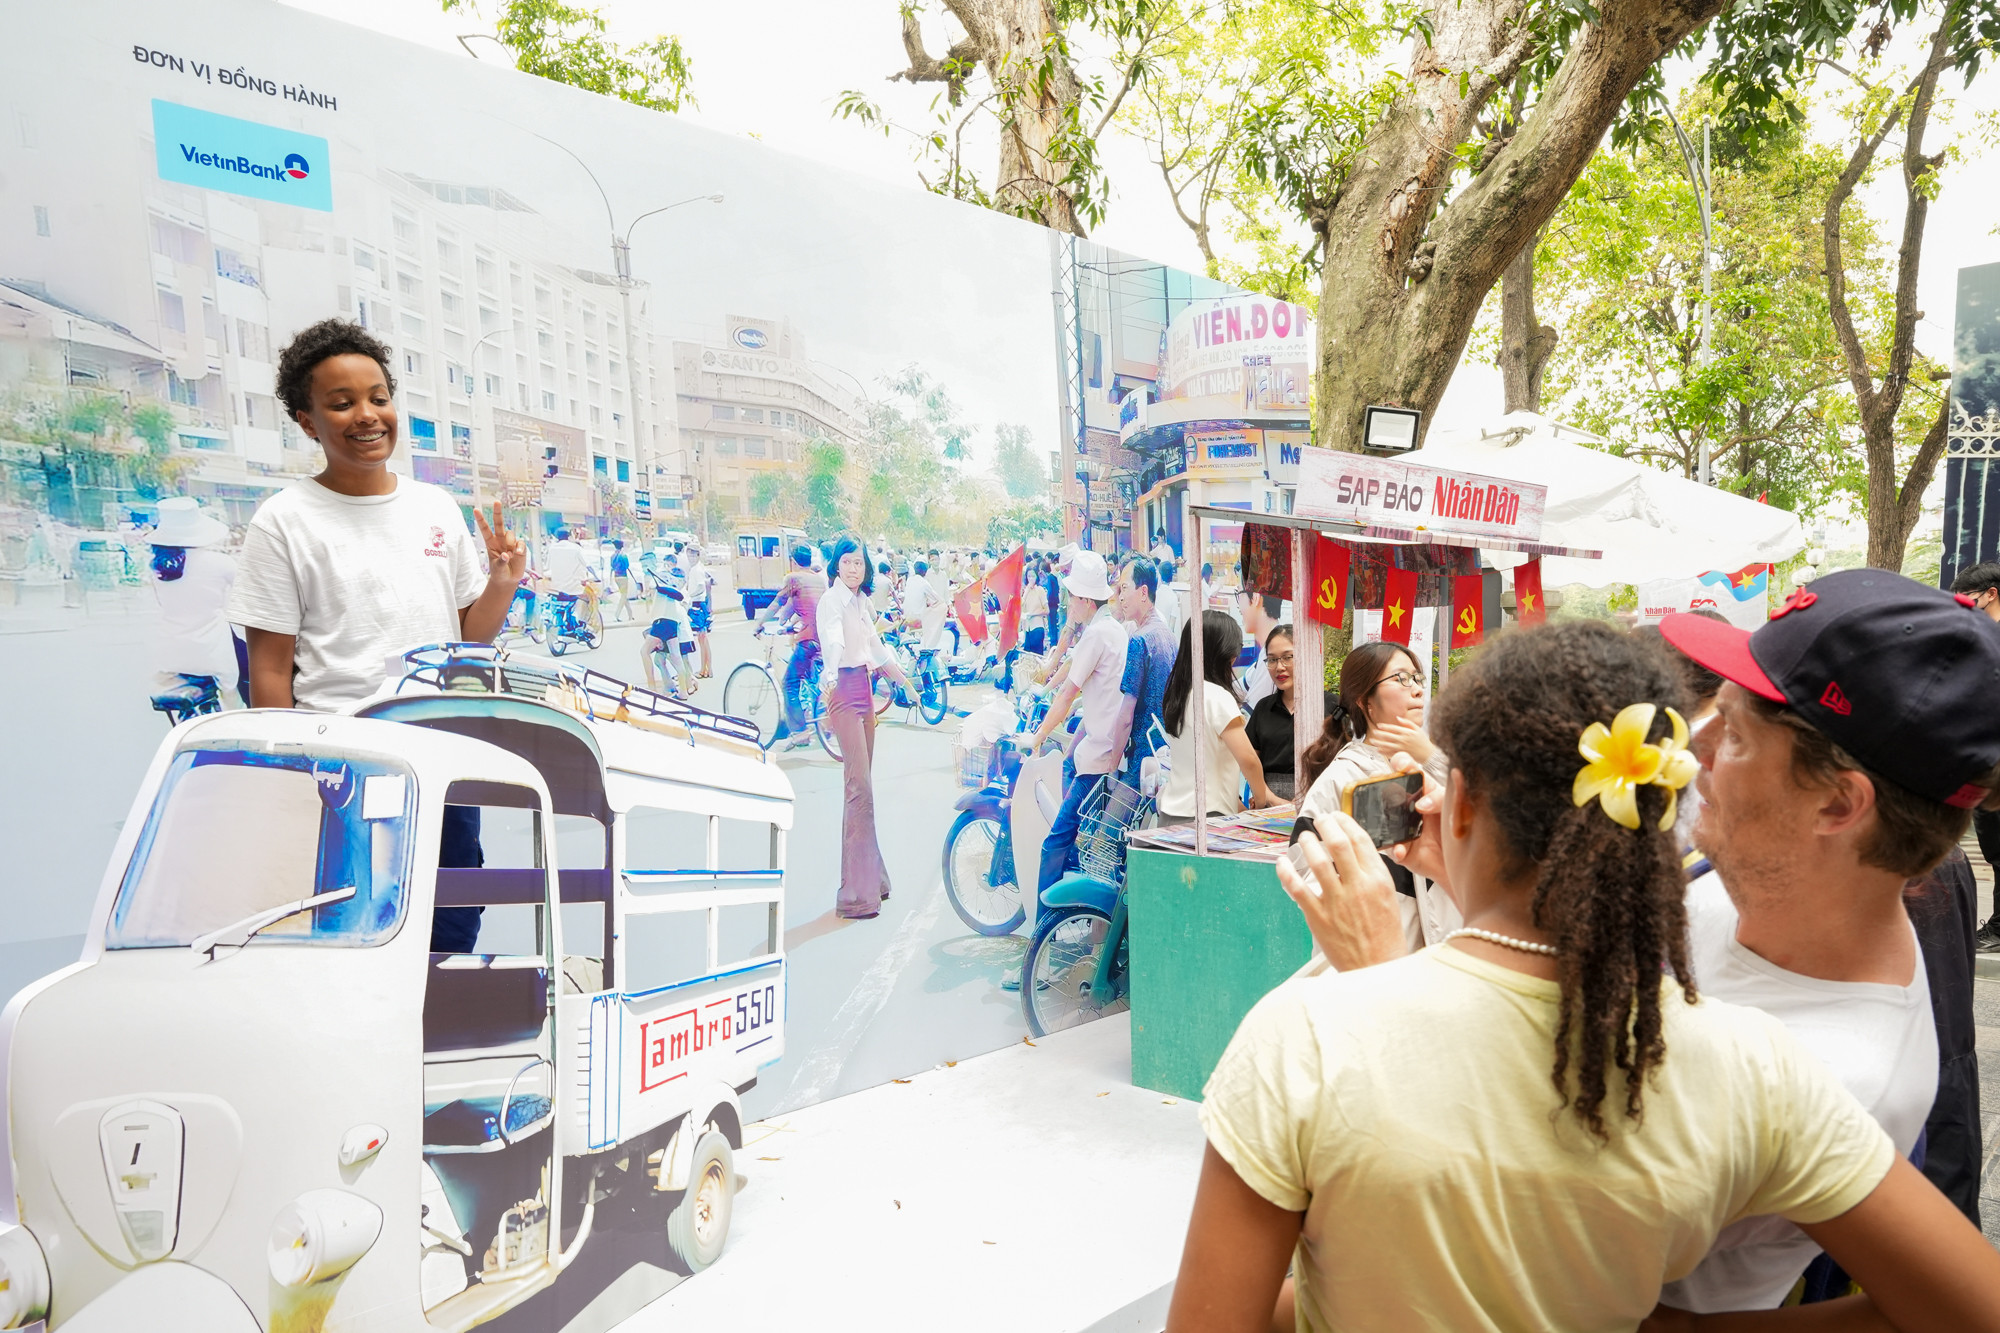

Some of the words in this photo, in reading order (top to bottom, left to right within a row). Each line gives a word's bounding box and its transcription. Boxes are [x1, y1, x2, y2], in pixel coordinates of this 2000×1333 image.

[132, 45, 184, 73] ĐƠN
[190, 60, 212, 84] VỊ
[217, 66, 277, 96] ĐỒNG
[283, 84, 338, 111] HÀNH
[179, 143, 288, 182] VietinBank
[718, 353, 779, 374] SANYO
[1431, 475, 1485, 522] Nhân
[1482, 483, 1520, 526] Dân
[736, 985, 775, 1036] 550
